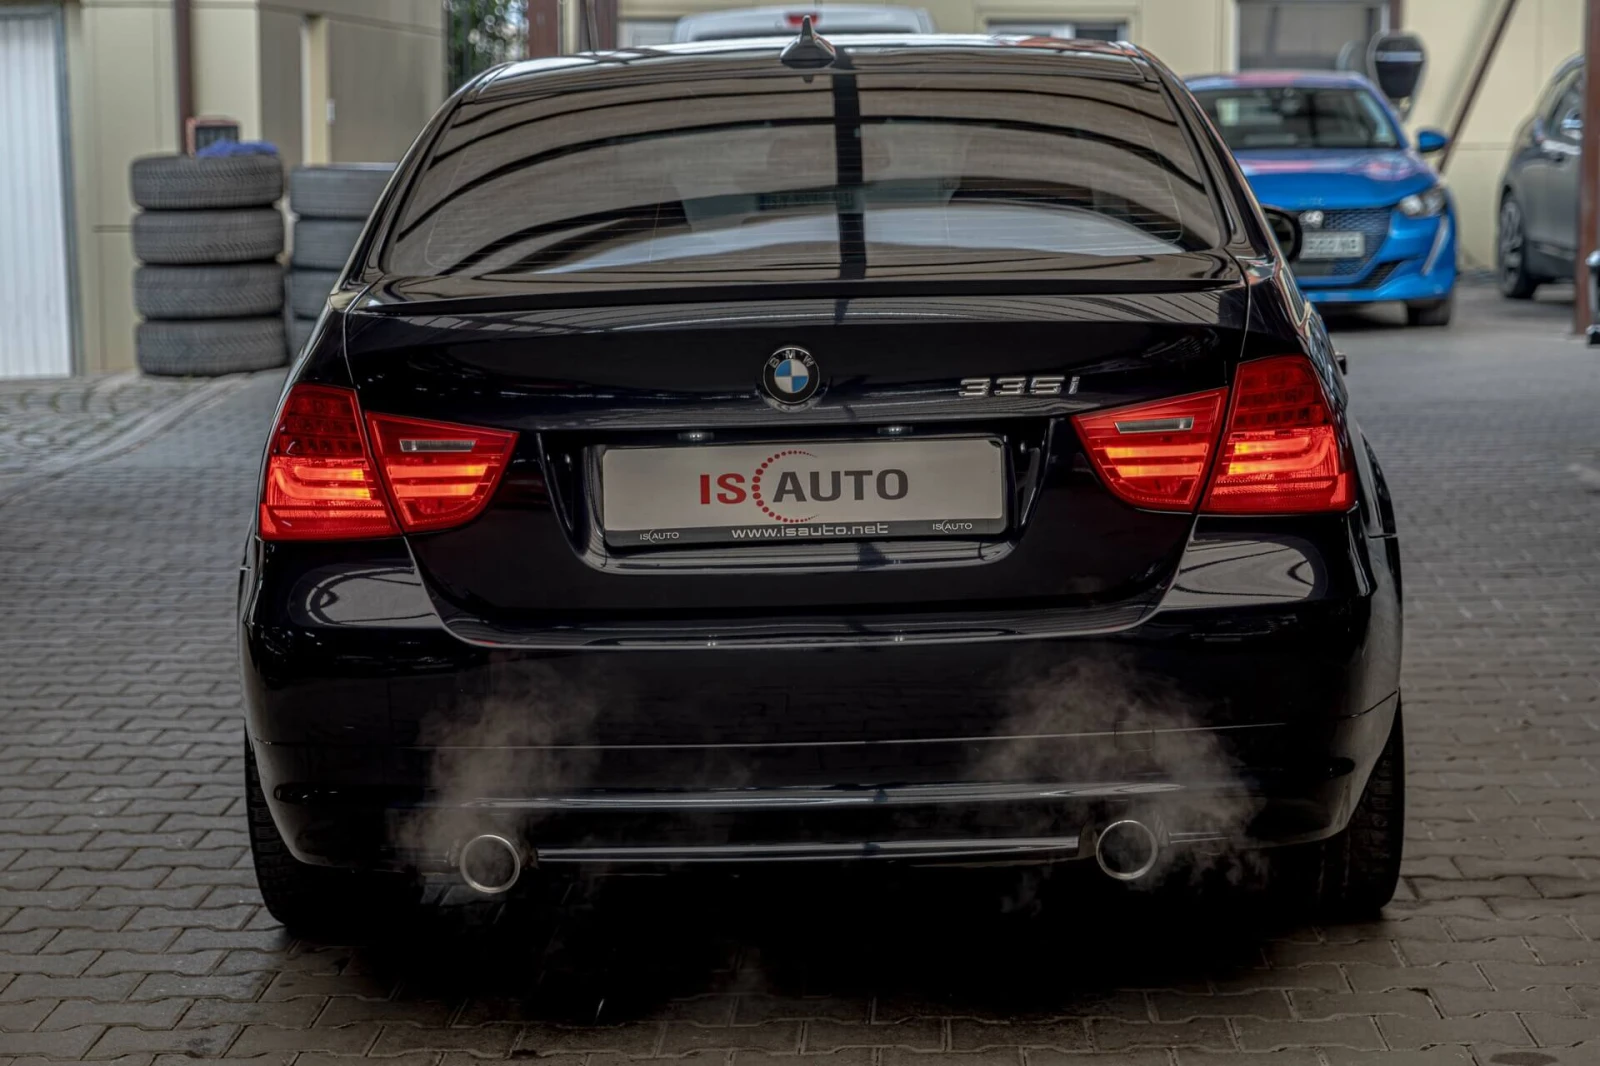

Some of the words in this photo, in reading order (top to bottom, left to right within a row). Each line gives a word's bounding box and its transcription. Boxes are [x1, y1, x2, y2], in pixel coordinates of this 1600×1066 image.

[768, 349, 815, 369] BMW
[958, 376, 1080, 397] 335i
[700, 473, 747, 504] IS
[772, 469, 909, 503] AUTO
[731, 522, 889, 539] www.isauto.net
